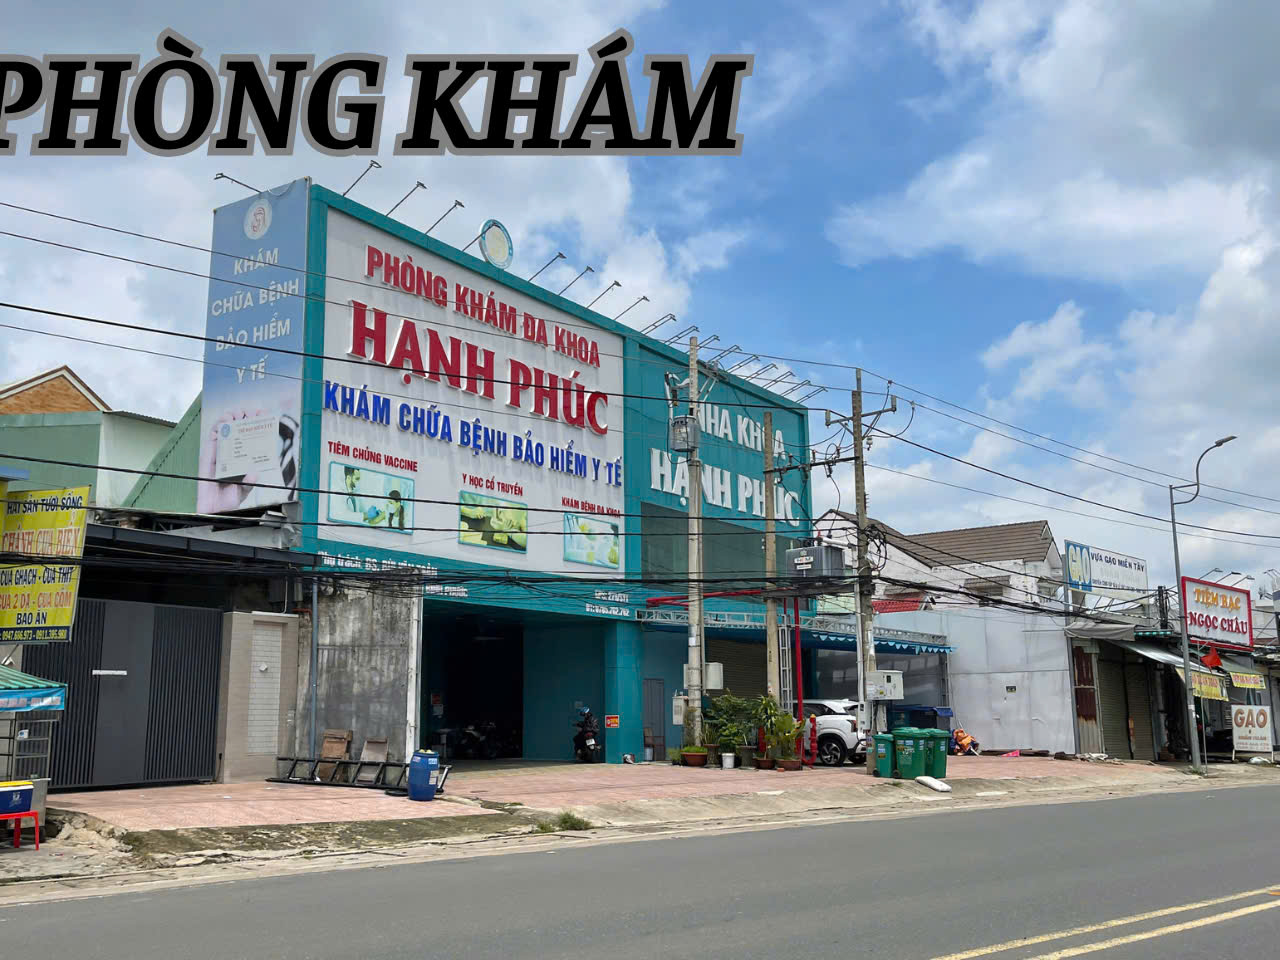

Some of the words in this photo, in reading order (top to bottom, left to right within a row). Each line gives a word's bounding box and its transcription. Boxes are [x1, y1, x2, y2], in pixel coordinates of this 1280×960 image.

[234, 248, 279, 275] KHÁM
[212, 291, 254, 316] CHỮA
[259, 278, 299, 306] BỆNH
[366, 243, 448, 306] PHÒNG
[454, 281, 517, 335] KHÁM
[521, 310, 549, 343] ĐA
[553, 325, 601, 368] KHOA
[215, 326, 248, 352] BẢO
[253, 312, 290, 344] HIỂM
[237, 367, 245, 384] Y
[250, 354, 269, 381] TẾ
[347, 300, 496, 401] HẠNH
[505, 357, 609, 436] PHÚC
[322, 379, 391, 425] KHÁM
[398, 401, 453, 442] CHỮA
[458, 417, 508, 458] BỆNH
[512, 430, 546, 467] BẢO
[548, 439, 588, 478] HIỂM
[591, 457, 603, 481] Y
[605, 456, 624, 487] TẾ
[737, 414, 786, 460] KHA
[328, 440, 350, 457] TIÊM
[352, 446, 382, 464] CHỦNG
[384, 454, 418, 472] VACCINE
[469, 475, 484, 490] HỌC
[1194, 588, 1219, 609] TIỆM
[1220, 595, 1241, 613] BẠC
[16, 611, 33, 625] BAO
[1189, 611, 1218, 632] NGỌC
[1221, 616, 1248, 634] CHÂU
